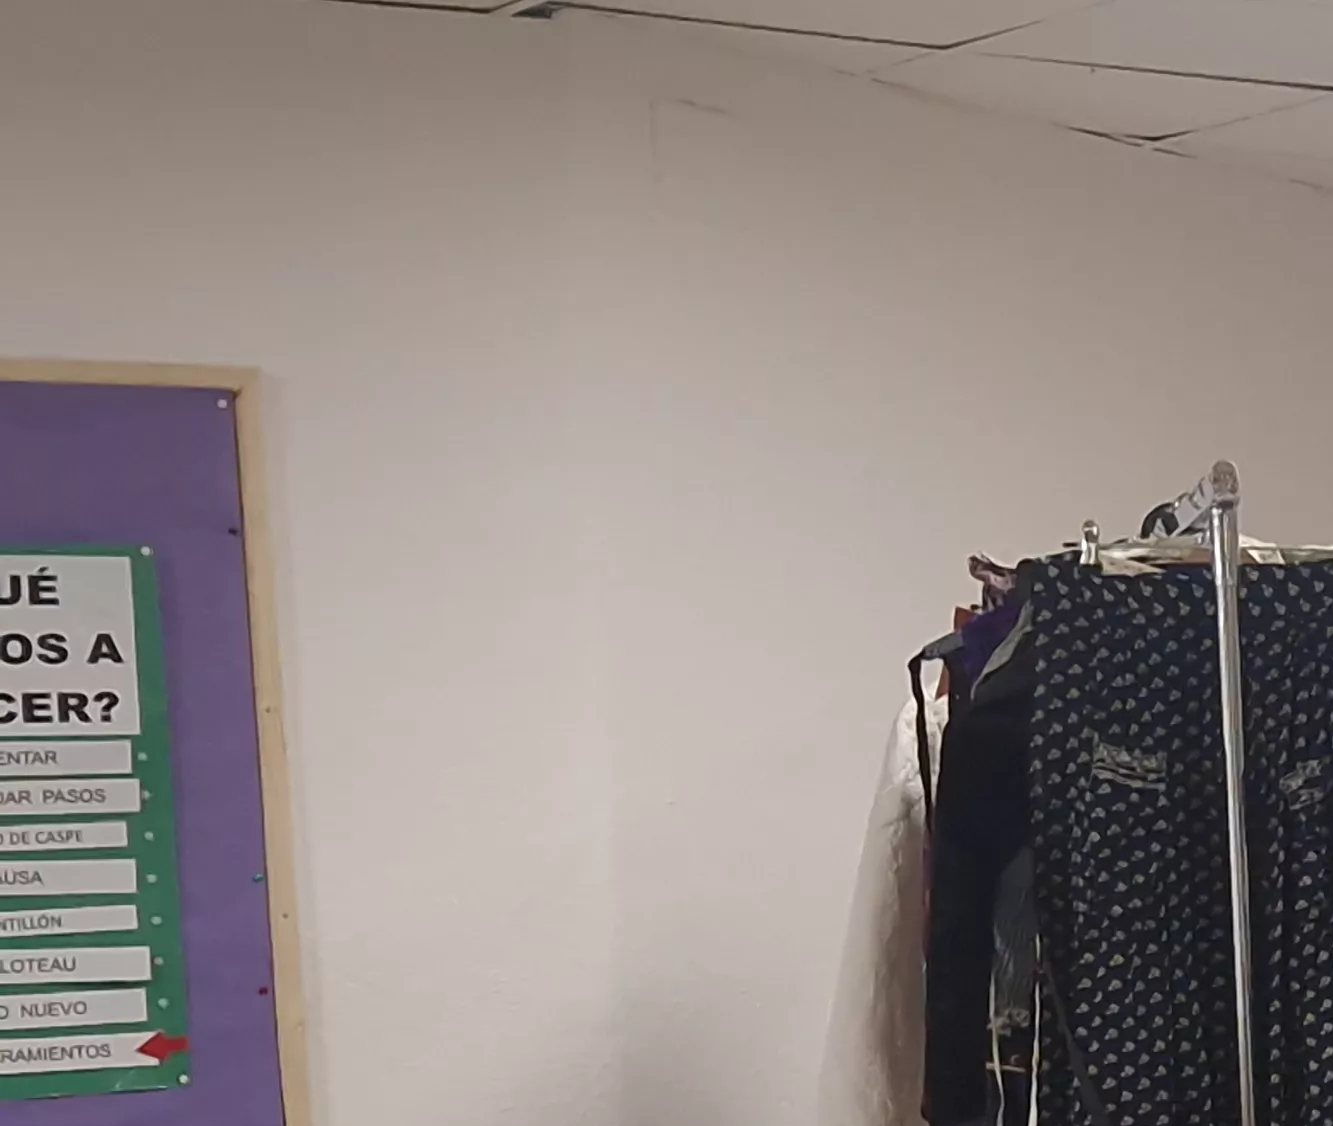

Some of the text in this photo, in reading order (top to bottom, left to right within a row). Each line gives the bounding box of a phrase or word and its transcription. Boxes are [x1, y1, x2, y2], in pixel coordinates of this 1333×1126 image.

[0, 633, 124, 665] OS A
[0, 691, 120, 723] CER?
[42, 788, 107, 804] PASOS
[10, 831, 30, 845] DE
[35, 830, 84, 845] CASPE
[0, 870, 44, 886] USA
[20, 1001, 87, 1018] NUEVO
[0, 1043, 111, 1064] RAMIENTOS
